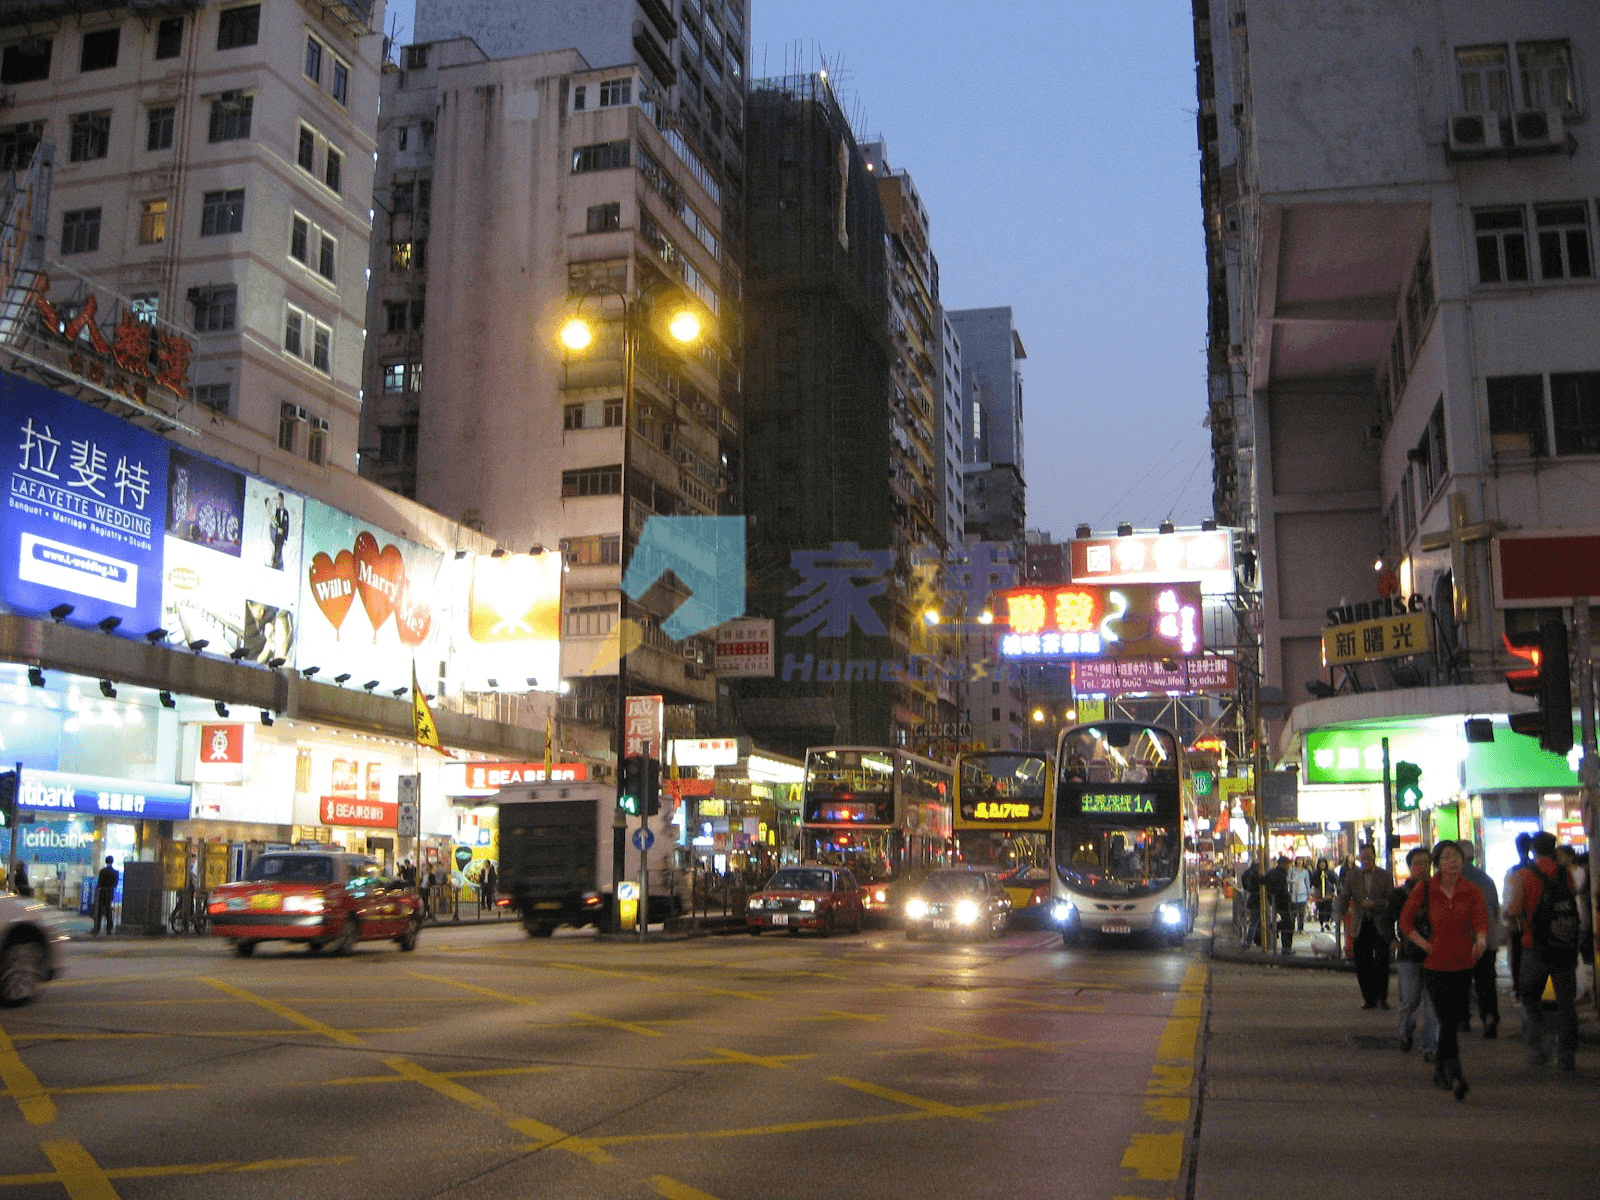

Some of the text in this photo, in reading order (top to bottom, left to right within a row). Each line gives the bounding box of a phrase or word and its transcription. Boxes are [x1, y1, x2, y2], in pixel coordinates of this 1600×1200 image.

[19, 418, 150, 510] 拉斐特
[9, 497, 152, 551] Banquet Marriage Registry Studio
[11, 476, 151, 536] LAFAYETTE WEDDING
[316, 577, 342, 602] Will
[359, 559, 396, 603] Marry
[1335, 621, 1413, 657] 新曙光
[336, 803, 356, 819] BEA
[26, 829, 87, 848] citibank
